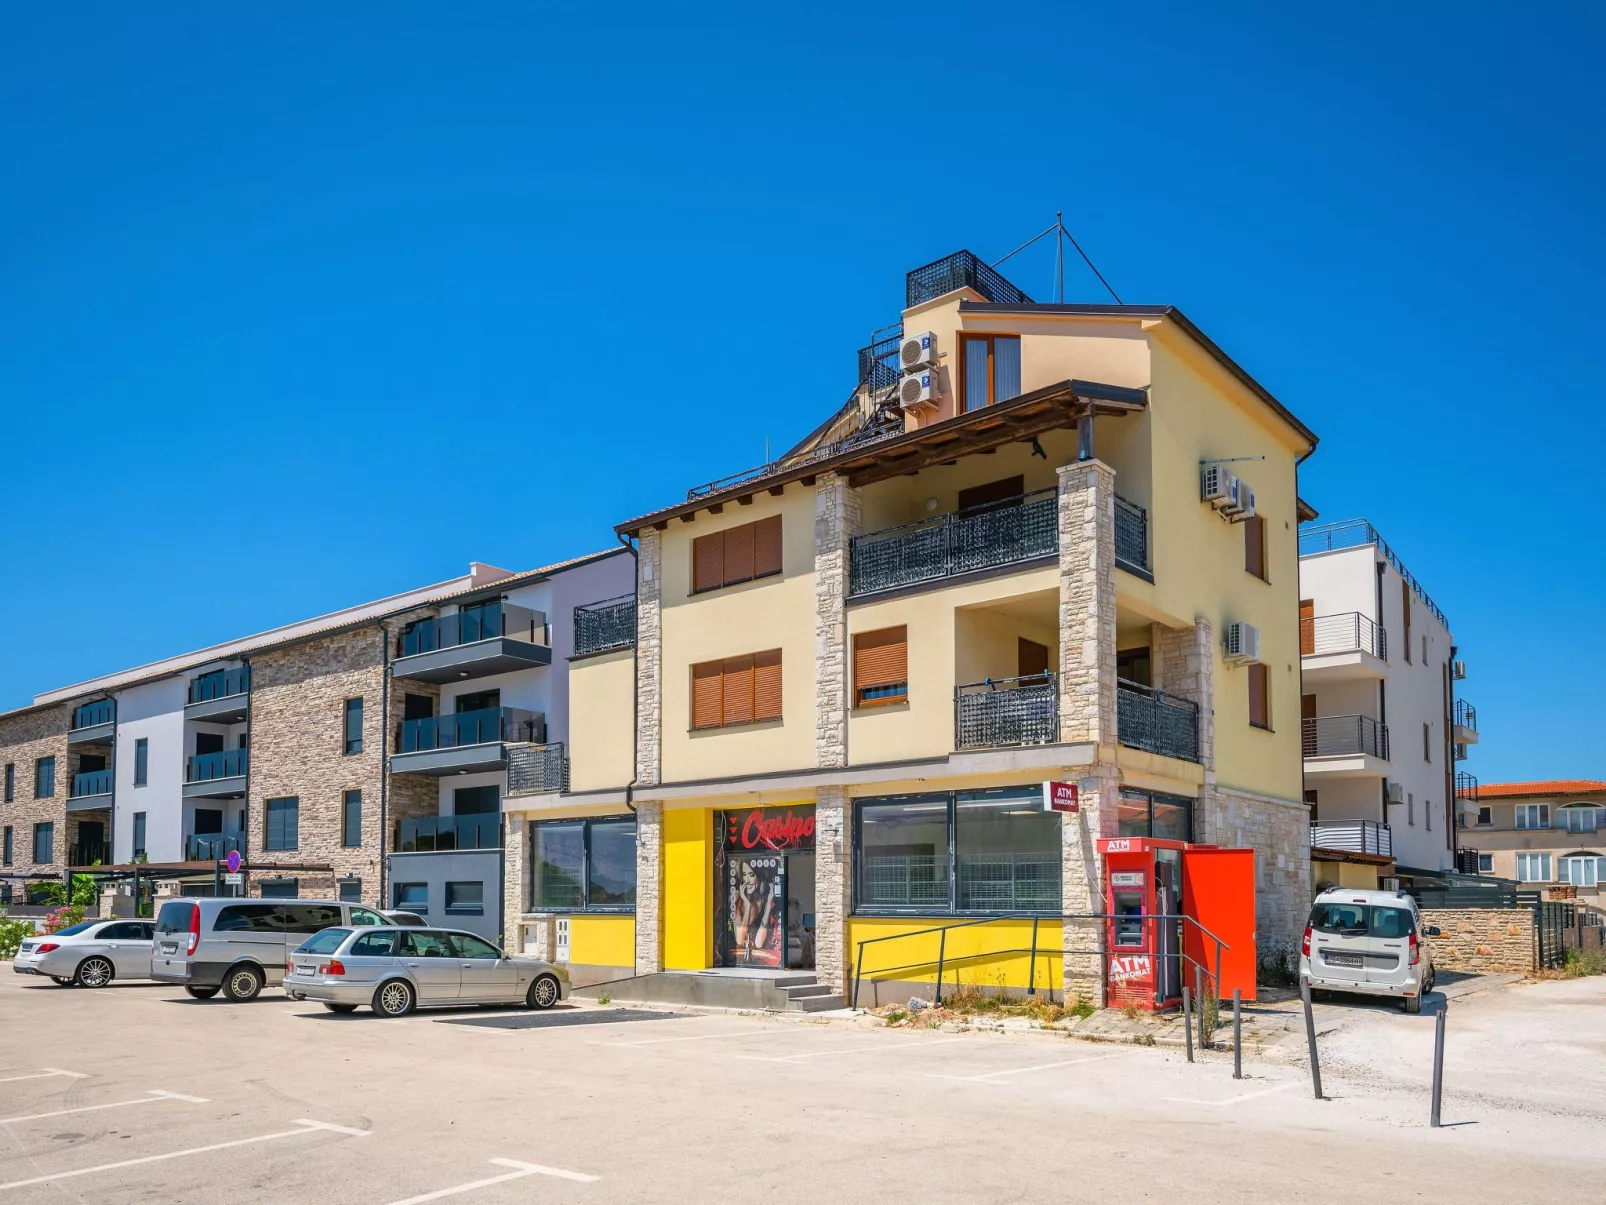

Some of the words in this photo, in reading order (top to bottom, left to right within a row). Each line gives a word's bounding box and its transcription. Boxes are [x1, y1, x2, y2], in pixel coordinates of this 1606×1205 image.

[1057, 787, 1072, 799] ATM
[741, 808, 817, 850] Casino
[1107, 840, 1130, 849] ATM
[1110, 954, 1150, 976] ATM
[1109, 967, 1151, 982] BANKOMAT
